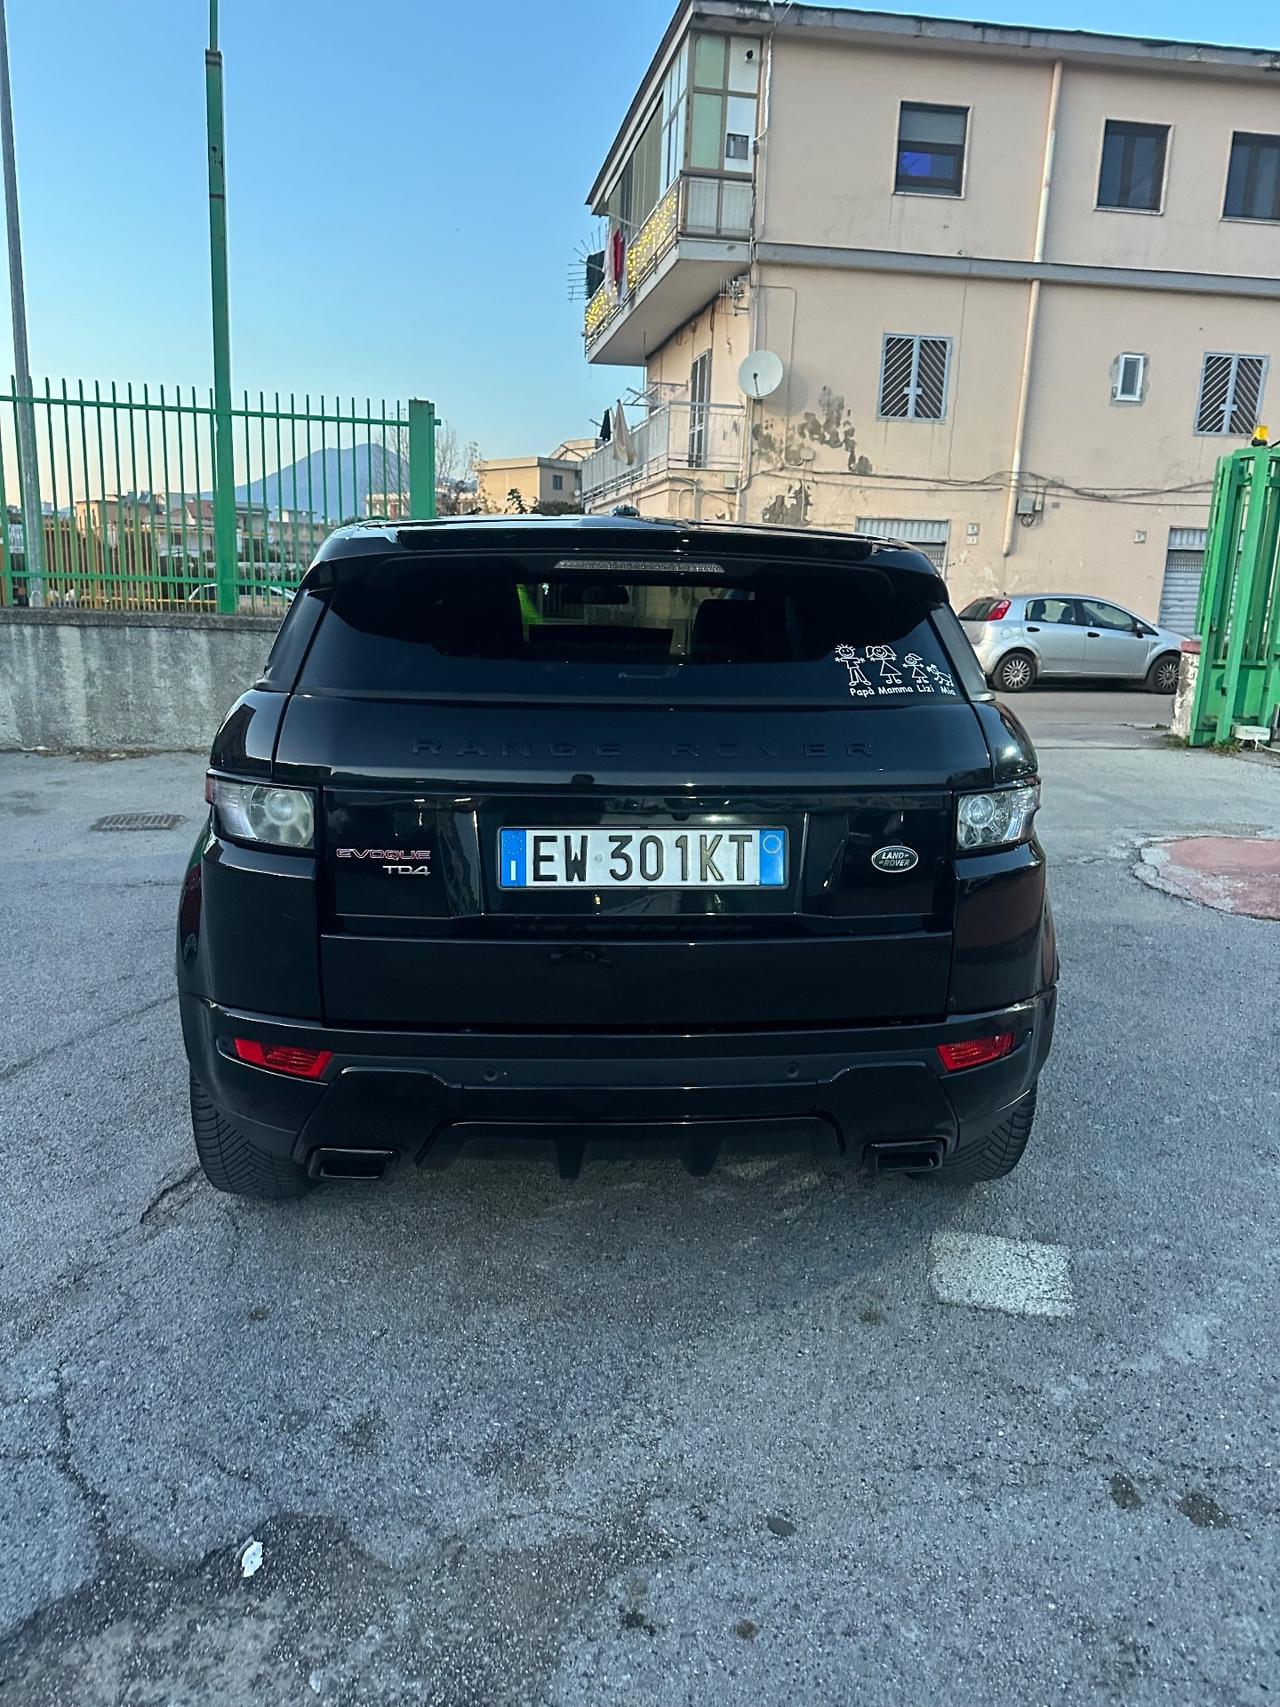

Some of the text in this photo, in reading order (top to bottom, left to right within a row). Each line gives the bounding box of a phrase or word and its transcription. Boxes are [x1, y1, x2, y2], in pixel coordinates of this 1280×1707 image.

[878, 686, 914, 695] Mamma
[917, 684, 935, 693] Lizi
[409, 739, 873, 757] RANGE ROVER
[336, 848, 431, 861] EVOQUE
[881, 851, 905, 860] LAND
[883, 859, 911, 867] ROVER
[382, 865, 431, 876] TD4
